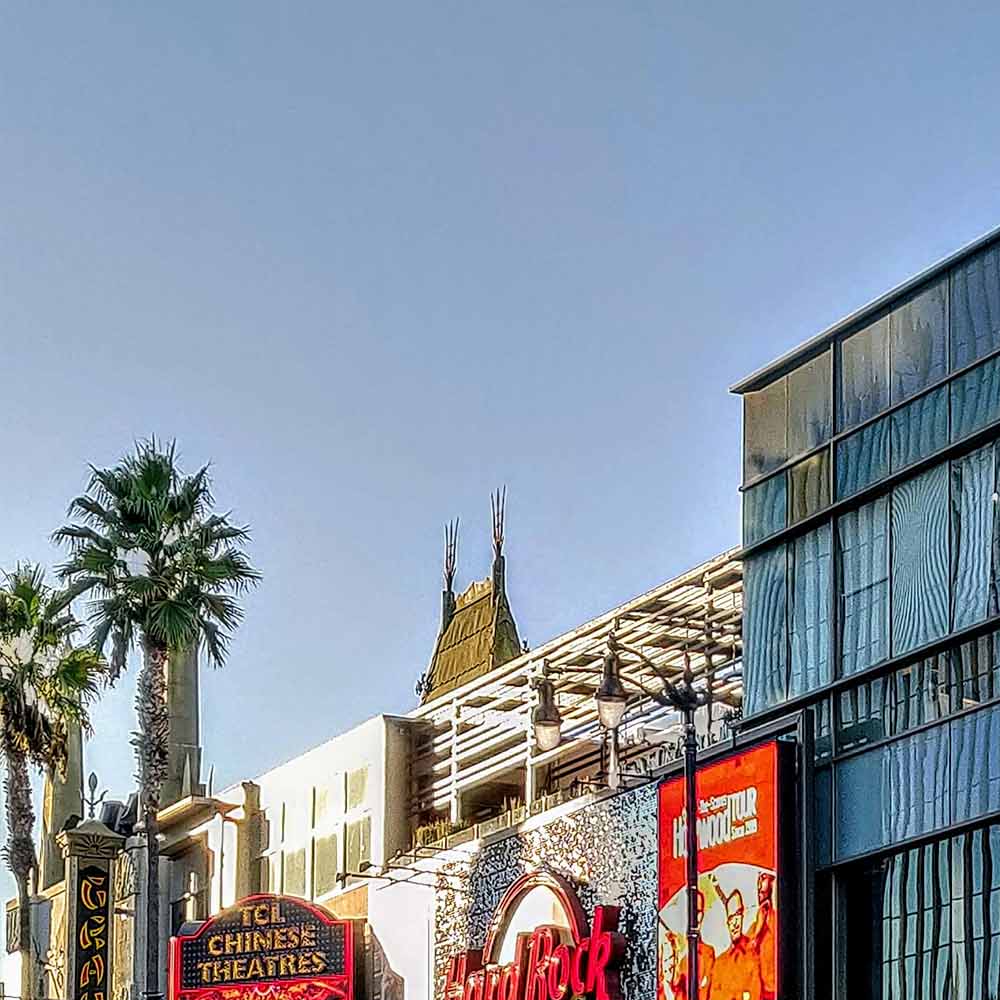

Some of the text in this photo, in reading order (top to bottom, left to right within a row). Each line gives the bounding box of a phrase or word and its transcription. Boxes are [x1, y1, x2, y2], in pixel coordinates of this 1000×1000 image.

[240, 901, 287, 926] TCL
[207, 922, 317, 955] CHINESE
[197, 950, 328, 983] THEATRES
